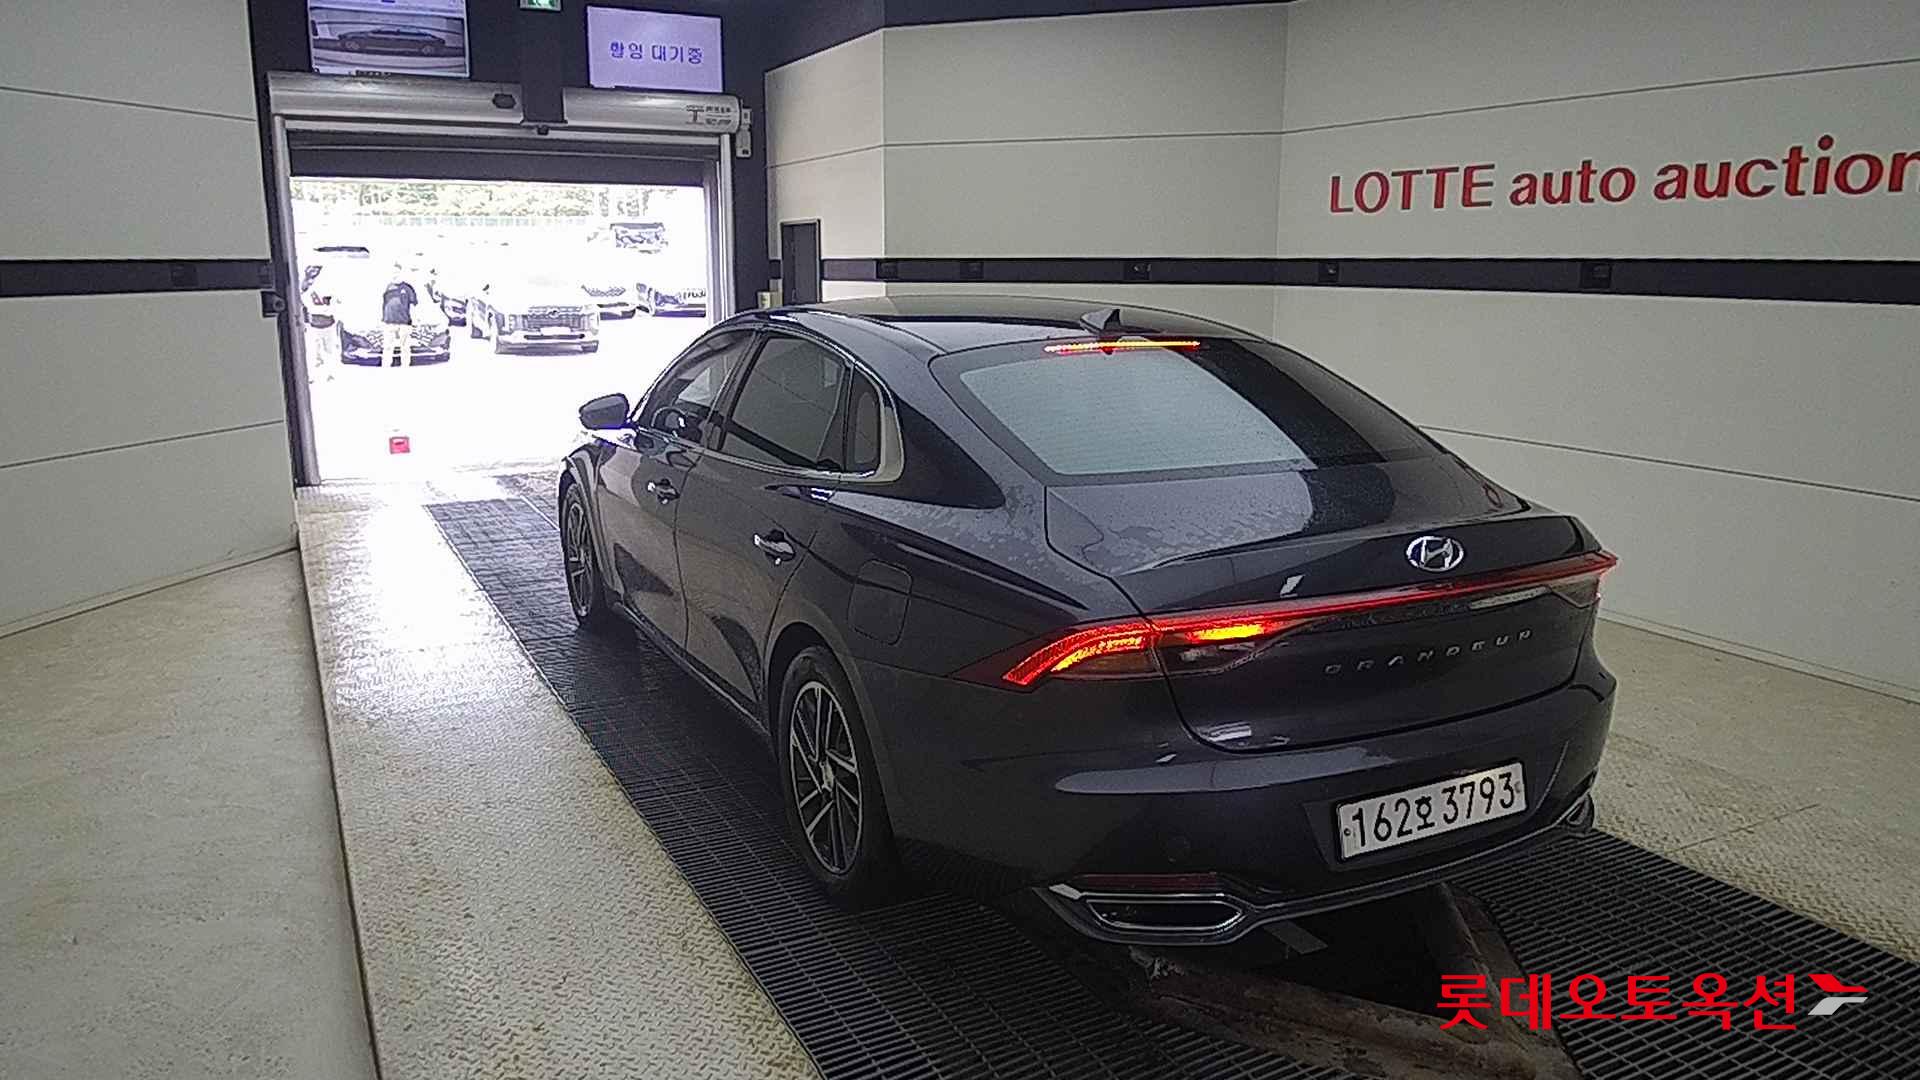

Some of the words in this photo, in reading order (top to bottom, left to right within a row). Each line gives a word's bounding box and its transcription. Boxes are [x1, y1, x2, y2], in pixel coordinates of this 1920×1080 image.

[651, 45, 703, 65] 대기중
[1329, 163, 1496, 214] LOTTE
[1509, 159, 1638, 206] auto
[1653, 134, 1920, 200] auction
